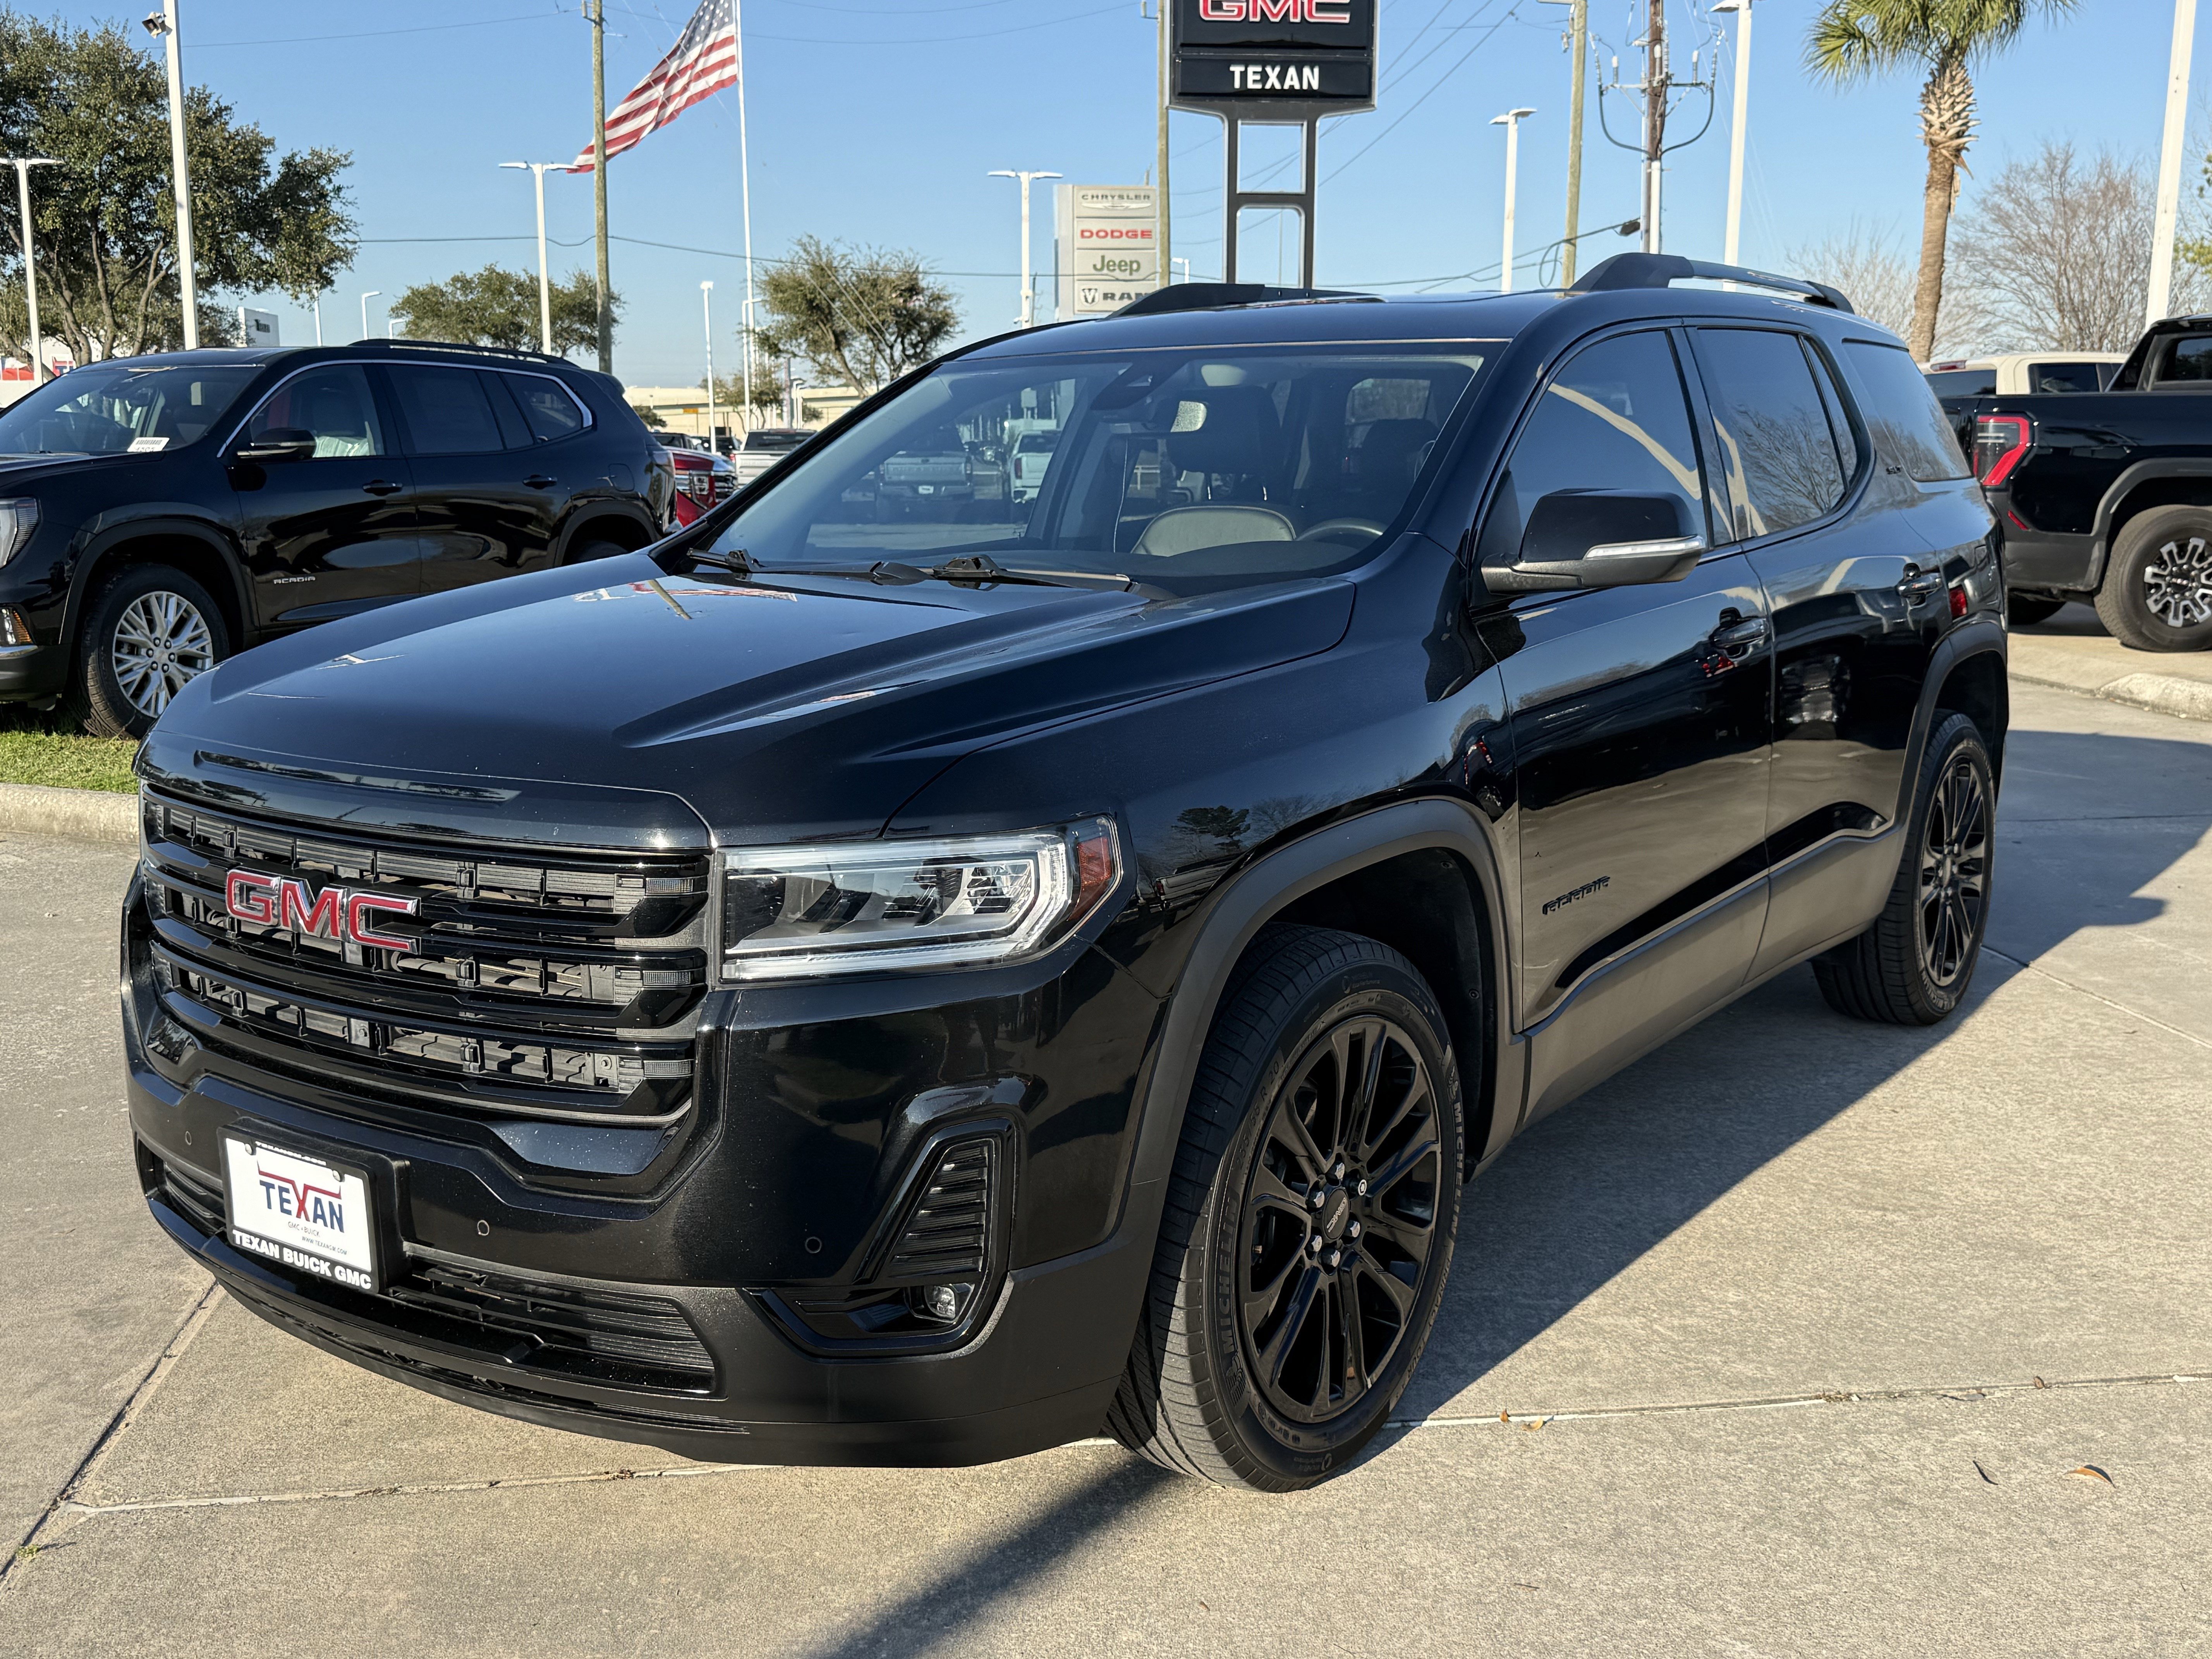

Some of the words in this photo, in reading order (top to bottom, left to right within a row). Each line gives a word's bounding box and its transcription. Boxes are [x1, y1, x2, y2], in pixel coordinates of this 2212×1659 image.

[1199, 0, 1351, 23] GMC
[1229, 64, 1319, 90] TEXAN
[1080, 229, 1153, 239] DODGE
[1092, 255, 1141, 276] Jeep
[226, 869, 421, 955] GMC
[1451, 1101, 1463, 1235] MICHELIN
[258, 1171, 345, 1233] TEXAN
[232, 1229, 280, 1259] TEXAN
[283, 1247, 332, 1277] BUICK
[334, 1265, 372, 1290] GMC
[1219, 1195, 1238, 1354] MICHELIN
